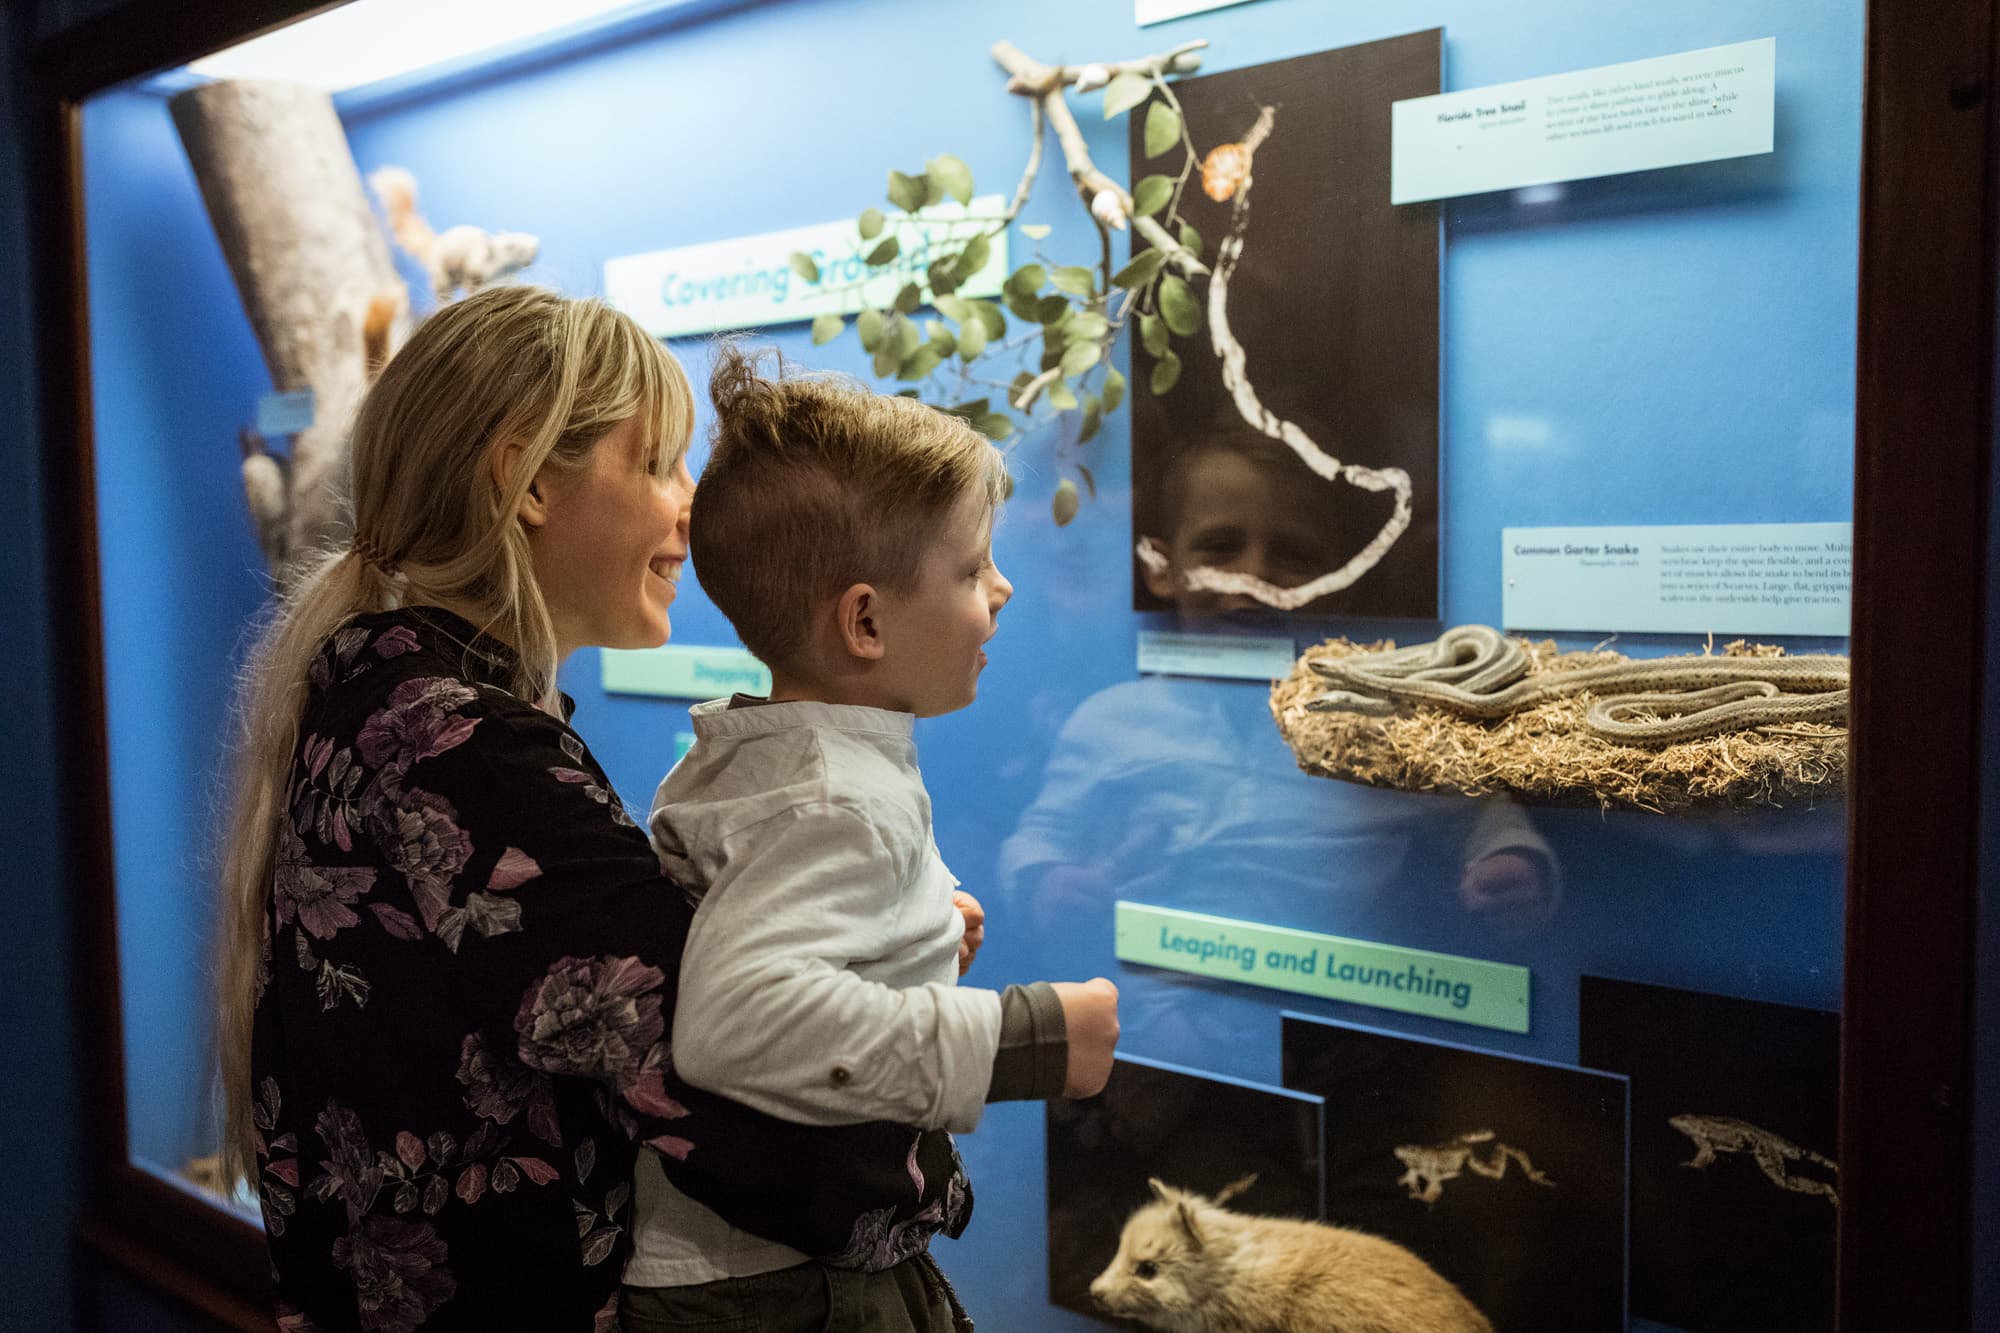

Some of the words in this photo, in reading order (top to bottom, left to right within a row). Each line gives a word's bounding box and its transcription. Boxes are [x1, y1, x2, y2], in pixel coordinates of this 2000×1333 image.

[661, 258, 792, 307] Covering
[1513, 543, 1560, 556] Common
[1563, 543, 1600, 556] Garter
[1603, 543, 1640, 556] Snake
[1804, 556, 1823, 565] and
[1158, 926, 1257, 971] Leaping
[1265, 946, 1317, 975] and
[1326, 952, 1472, 1009] Launching
